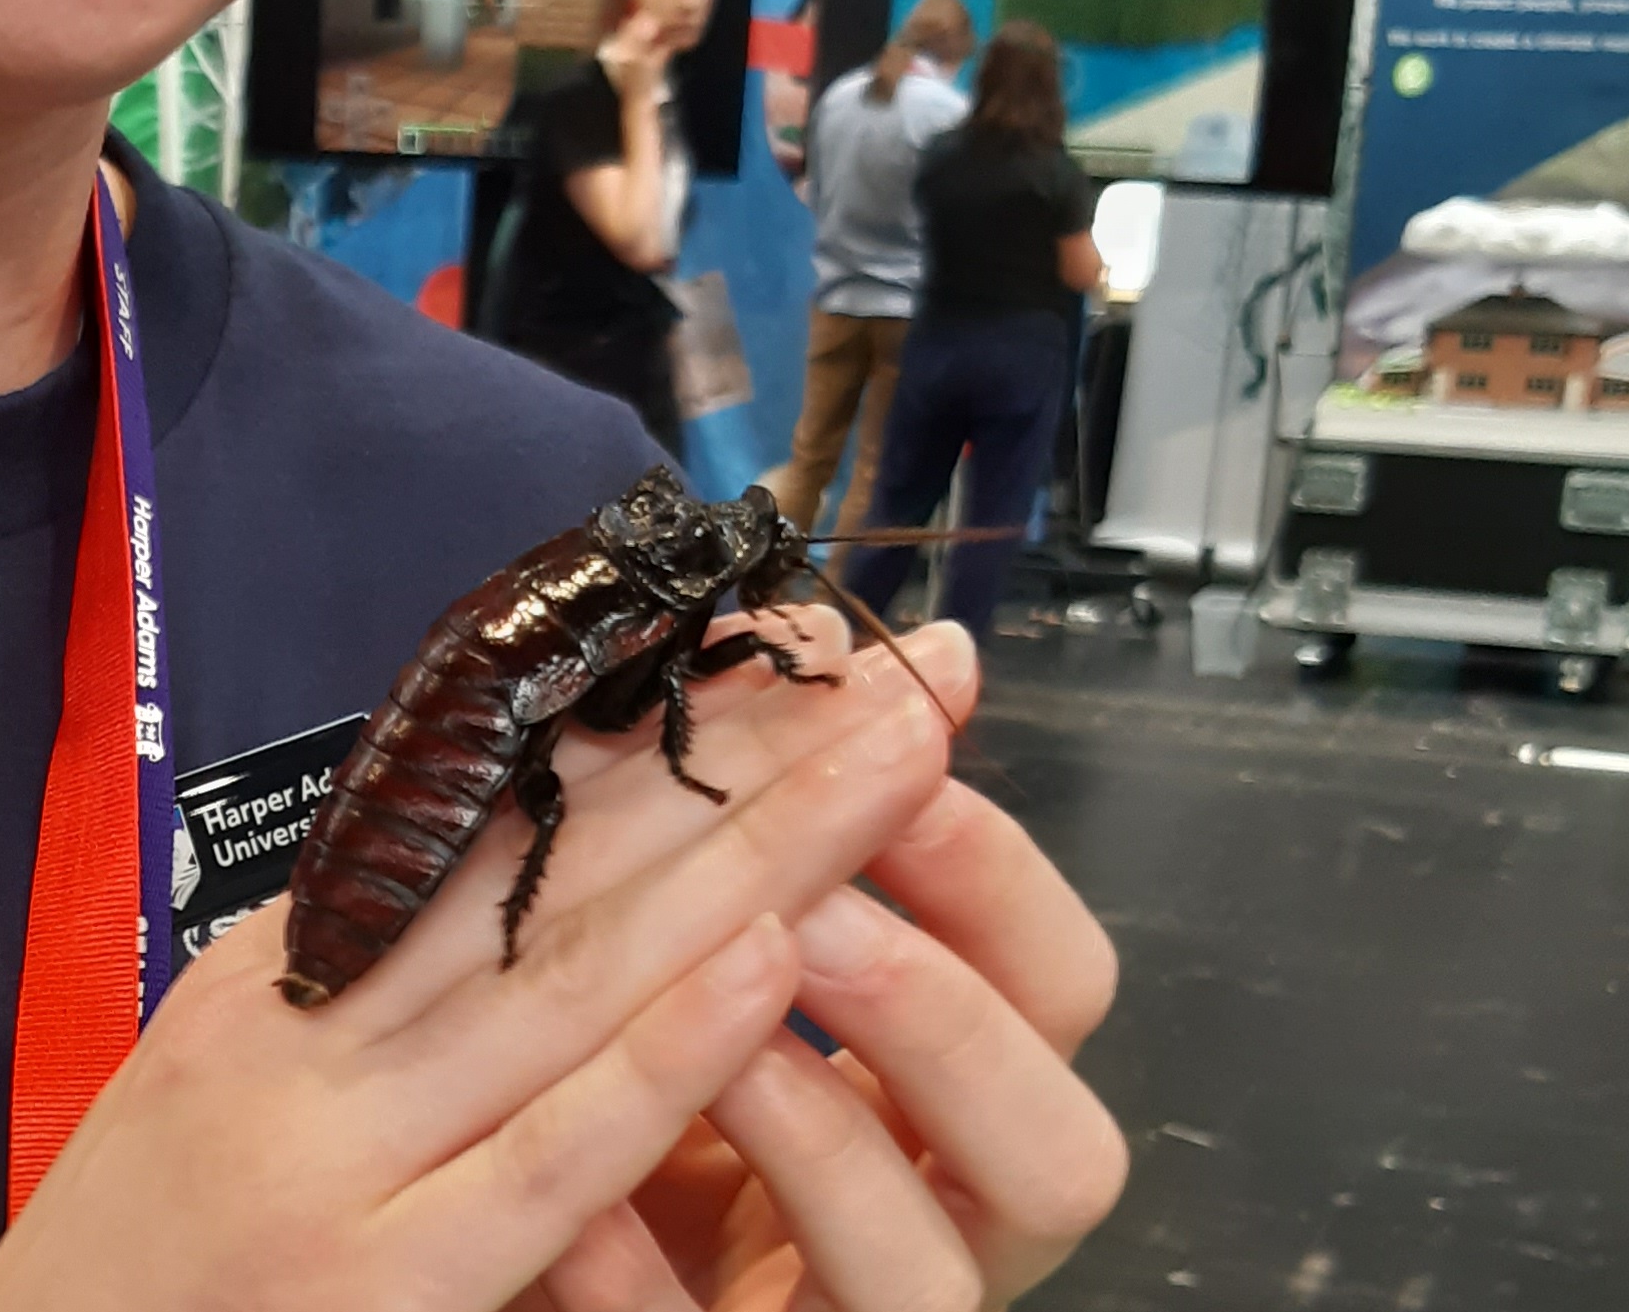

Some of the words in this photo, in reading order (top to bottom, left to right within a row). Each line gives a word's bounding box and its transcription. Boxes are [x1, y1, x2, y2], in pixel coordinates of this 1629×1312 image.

[114, 262, 133, 361] STAFF
[130, 494, 153, 589] Harper
[136, 589, 160, 689] Adams
[202, 786, 294, 835] Harper
